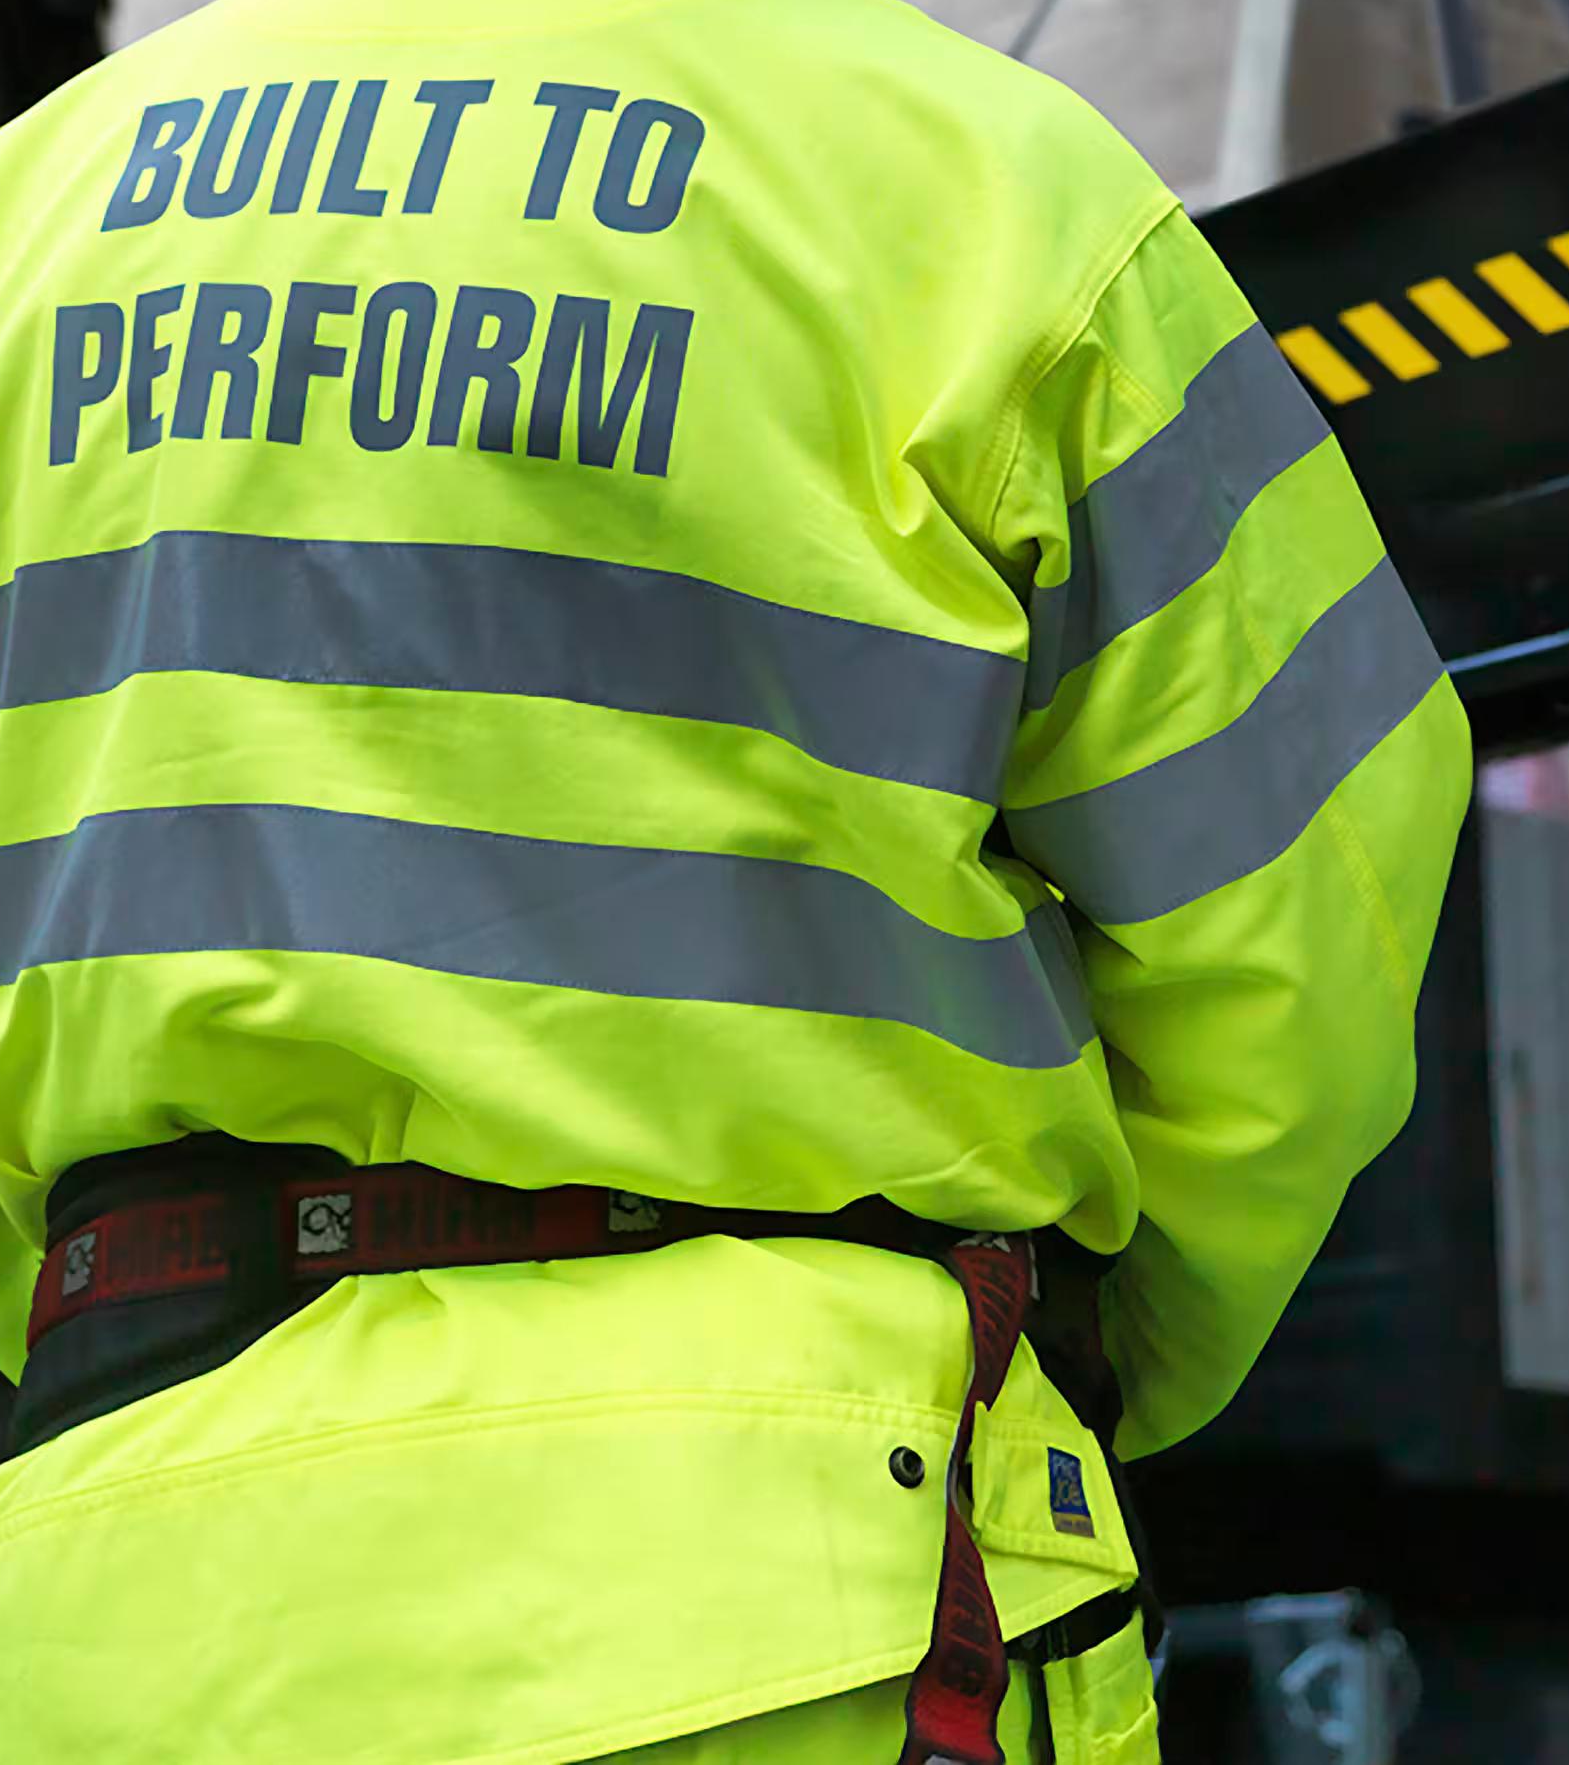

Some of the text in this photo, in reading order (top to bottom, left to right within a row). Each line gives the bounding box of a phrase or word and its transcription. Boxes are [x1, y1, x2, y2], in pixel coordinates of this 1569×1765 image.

[101, 79, 707, 234] BUILT TO
[48, 281, 696, 479] PERFORM
